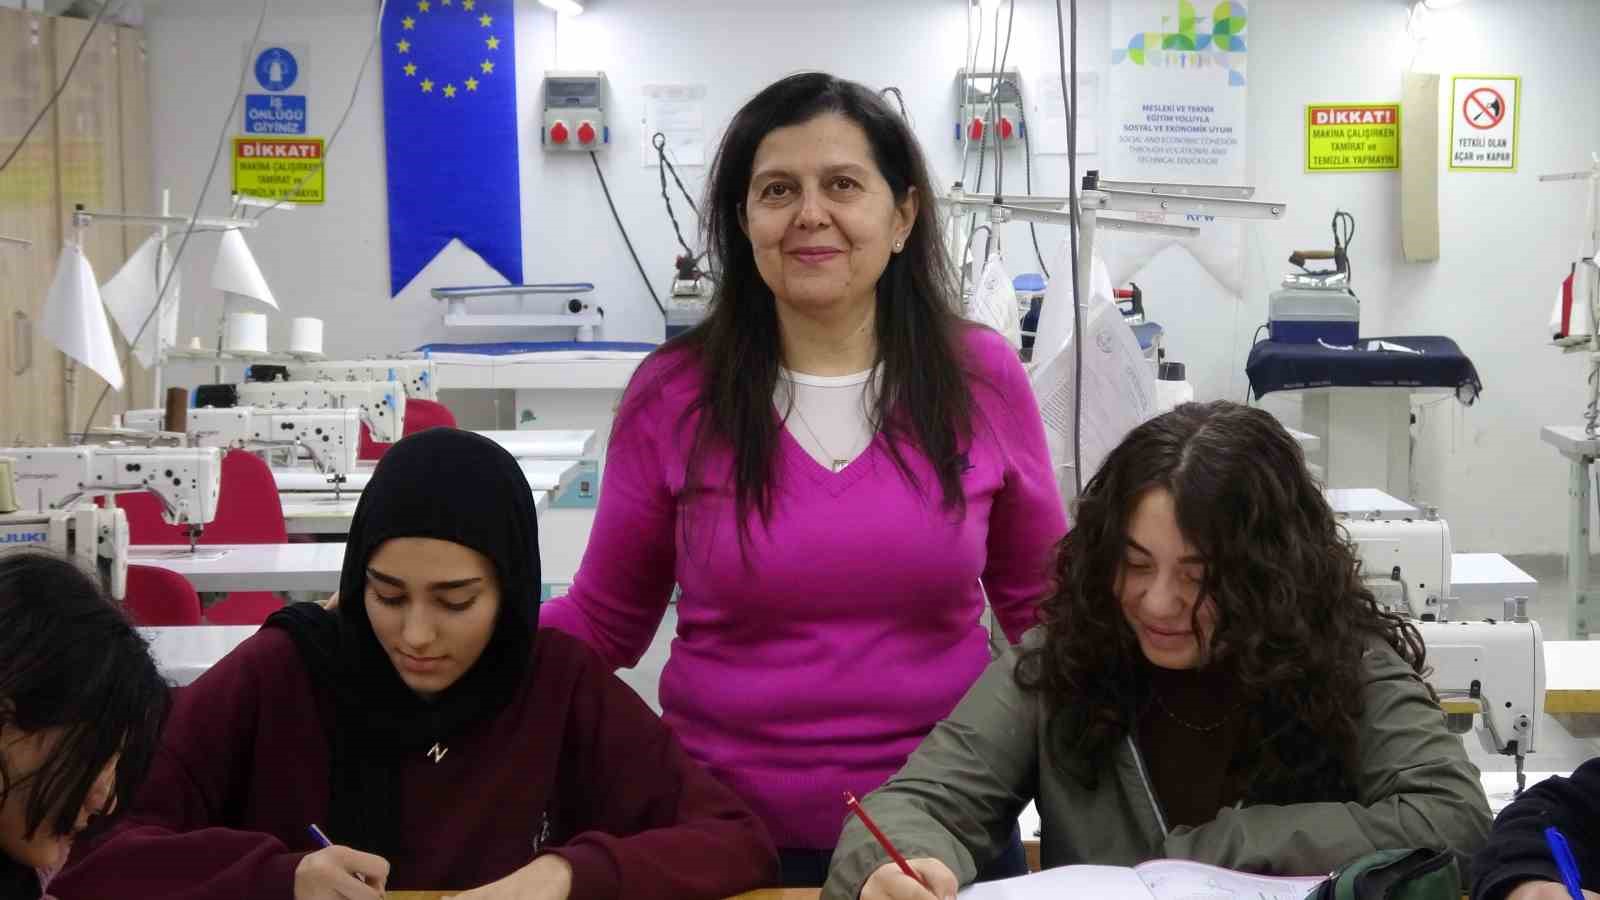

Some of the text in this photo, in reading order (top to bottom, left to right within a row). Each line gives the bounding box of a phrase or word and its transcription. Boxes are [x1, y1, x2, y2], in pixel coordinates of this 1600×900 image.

[1176, 104, 1185, 112] VE
[1316, 109, 1391, 124] DİKKAT!
[1124, 124, 1151, 132] SOSYAL
[1488, 138, 1506, 148] OLAN
[243, 142, 316, 157] DİKKAT!
[1455, 152, 1473, 162] AÇAR
[1487, 152, 1510, 161] KAPAR
